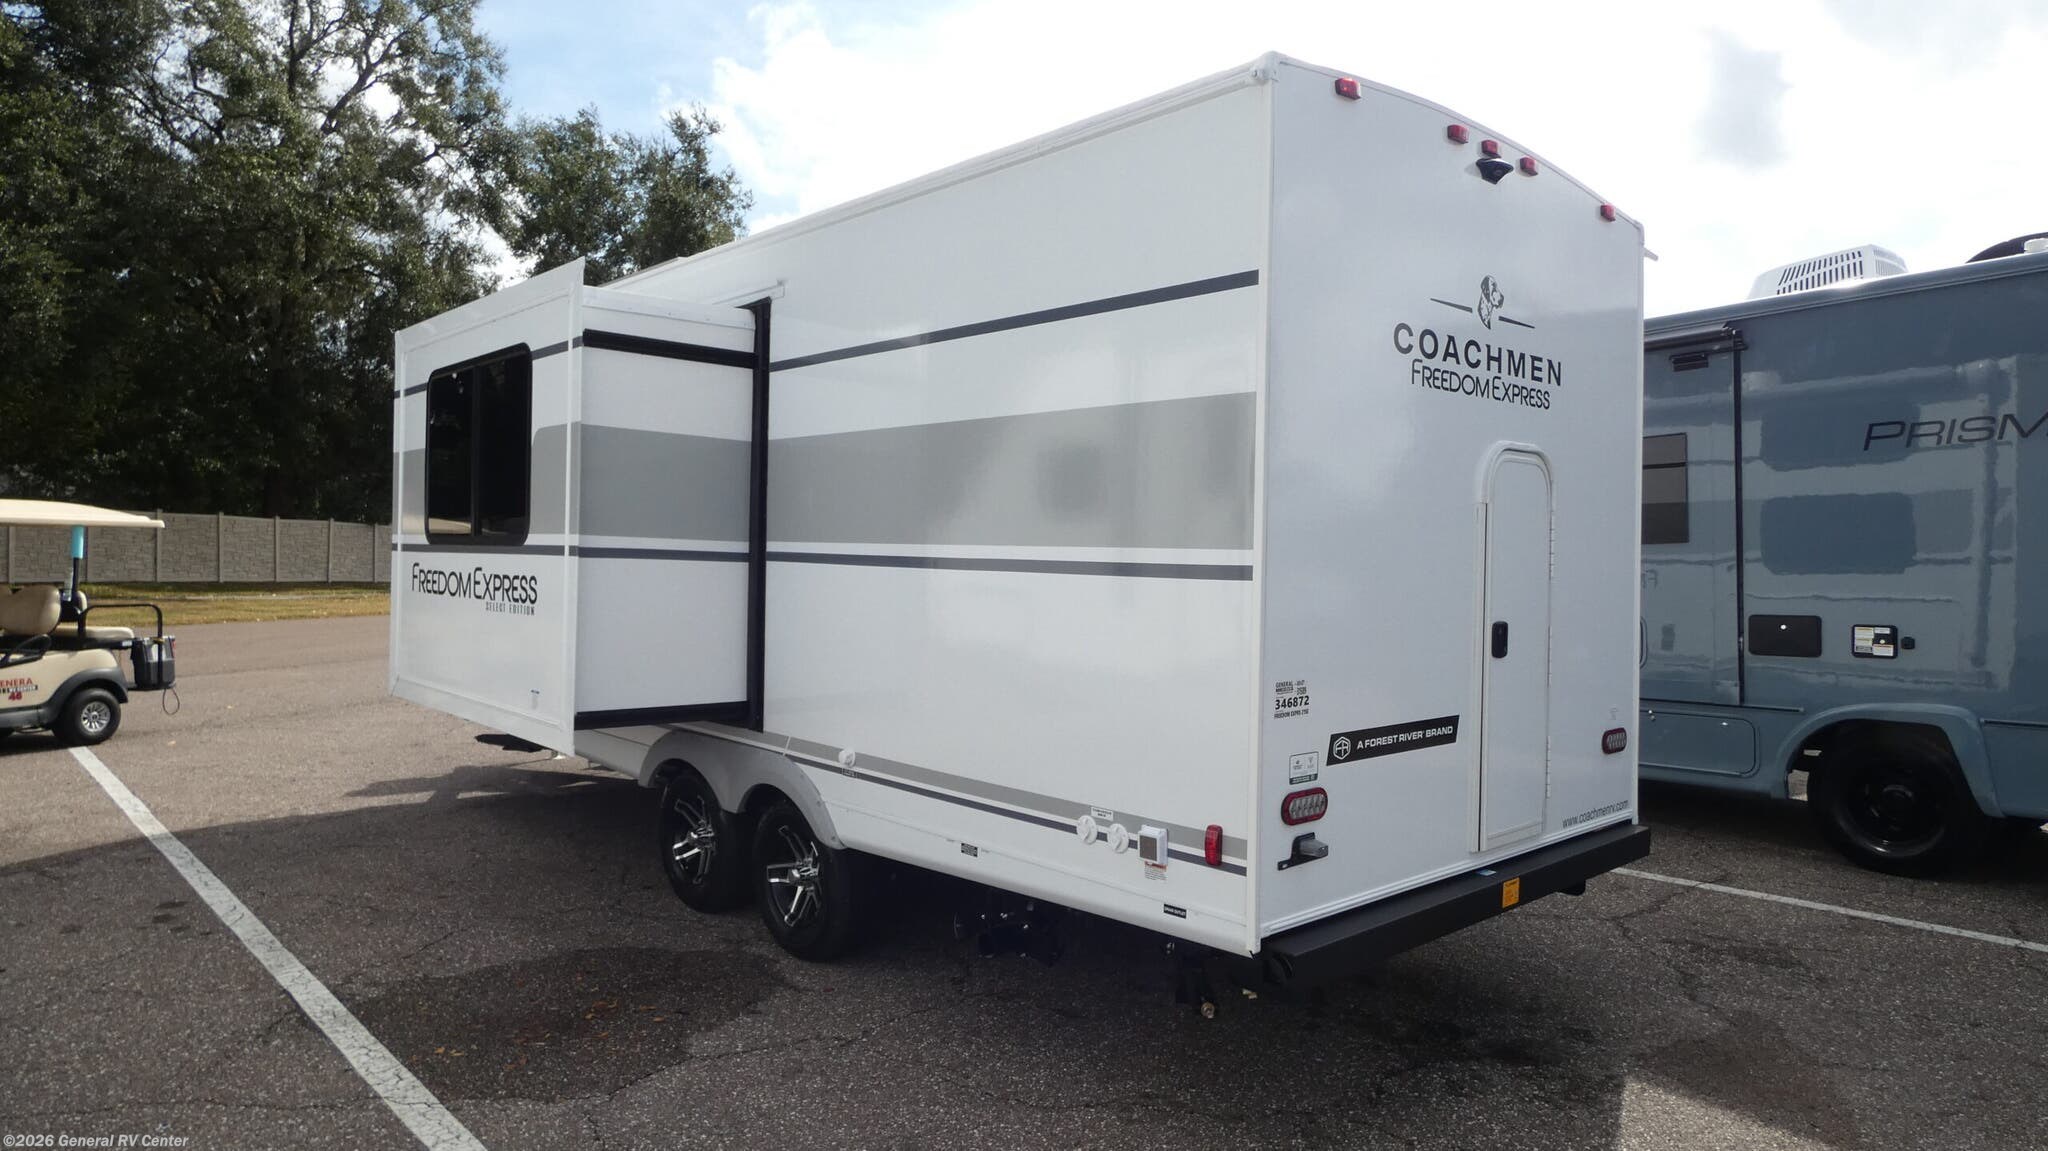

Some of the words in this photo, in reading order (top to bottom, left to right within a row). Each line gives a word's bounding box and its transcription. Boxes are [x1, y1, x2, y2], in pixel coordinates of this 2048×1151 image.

[1393, 322, 1562, 387] COACHMEN
[1863, 411, 2048, 451] PRISM
[509, 603, 535, 616] EDITION
[1275, 695, 1310, 710] 346872
[1356, 740, 1364, 750] A
[1364, 734, 1398, 748] FOREST
[1425, 726, 1453, 738] BRAND
